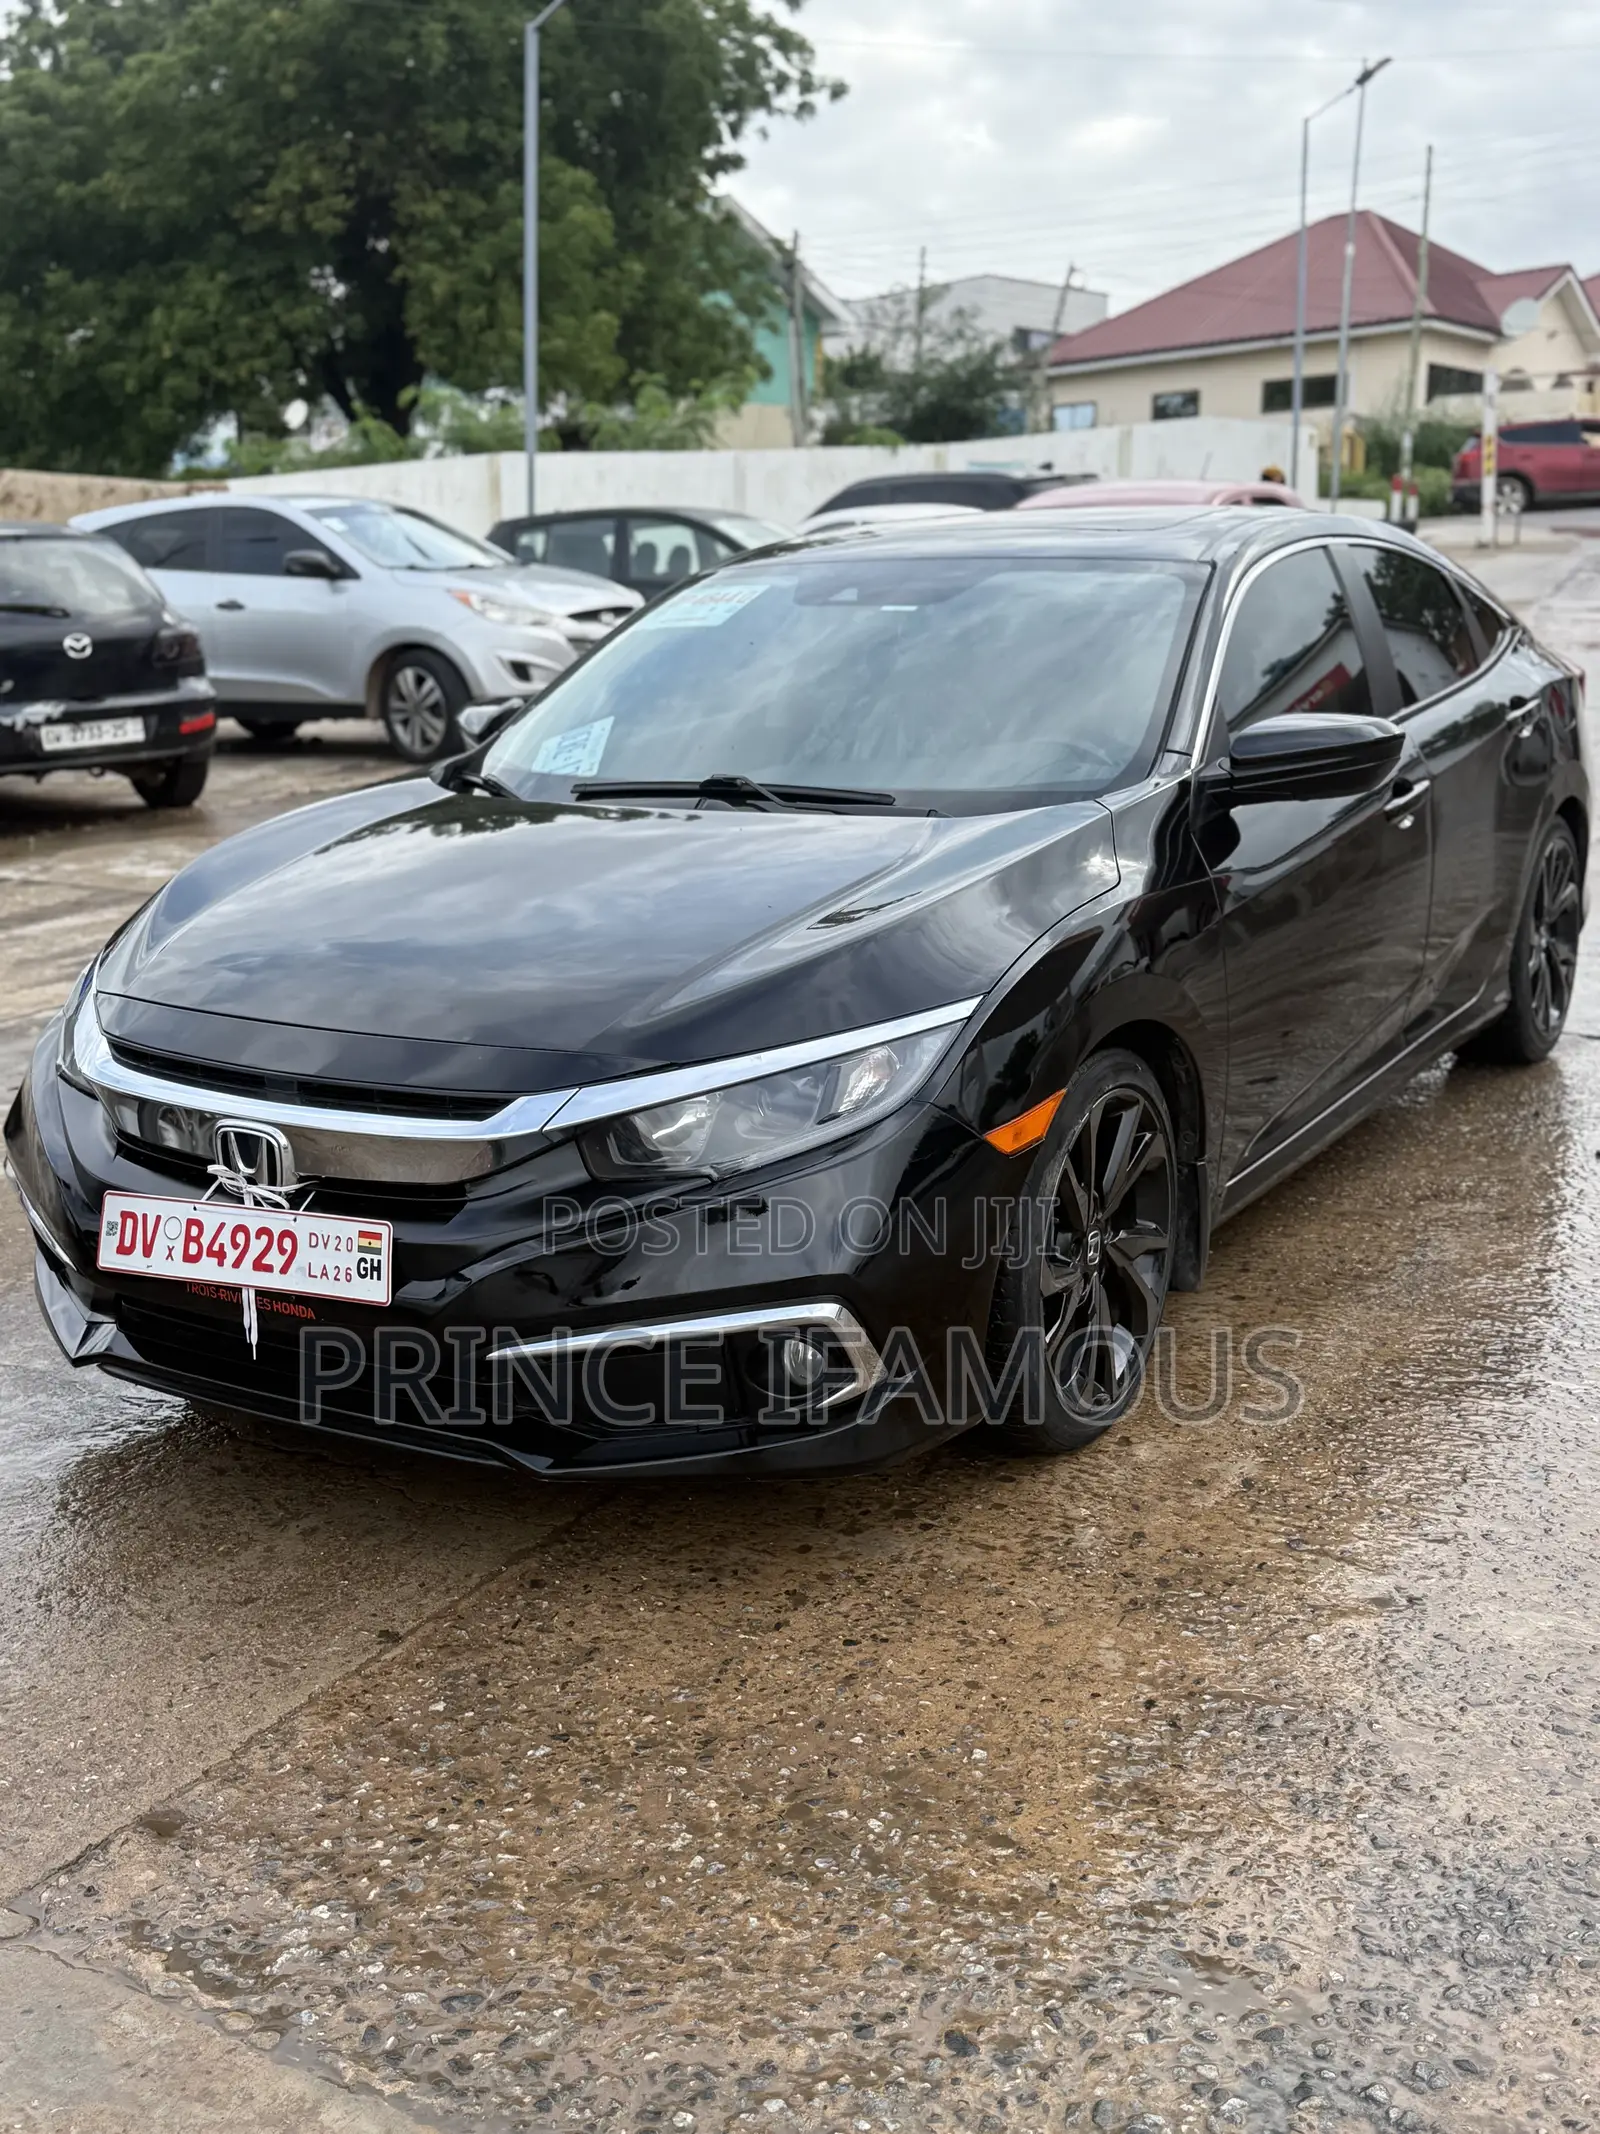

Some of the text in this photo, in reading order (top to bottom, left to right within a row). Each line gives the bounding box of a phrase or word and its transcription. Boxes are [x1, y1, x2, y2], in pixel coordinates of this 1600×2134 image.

[115, 1210, 162, 1259] DV
[182, 1218, 299, 1276] B4929
[308, 1232, 354, 1253] DV20
[308, 1262, 353, 1283] LA26
[356, 1257, 382, 1282] GH
[186, 1282, 316, 1320] TROIS-RIVIES HONDA
